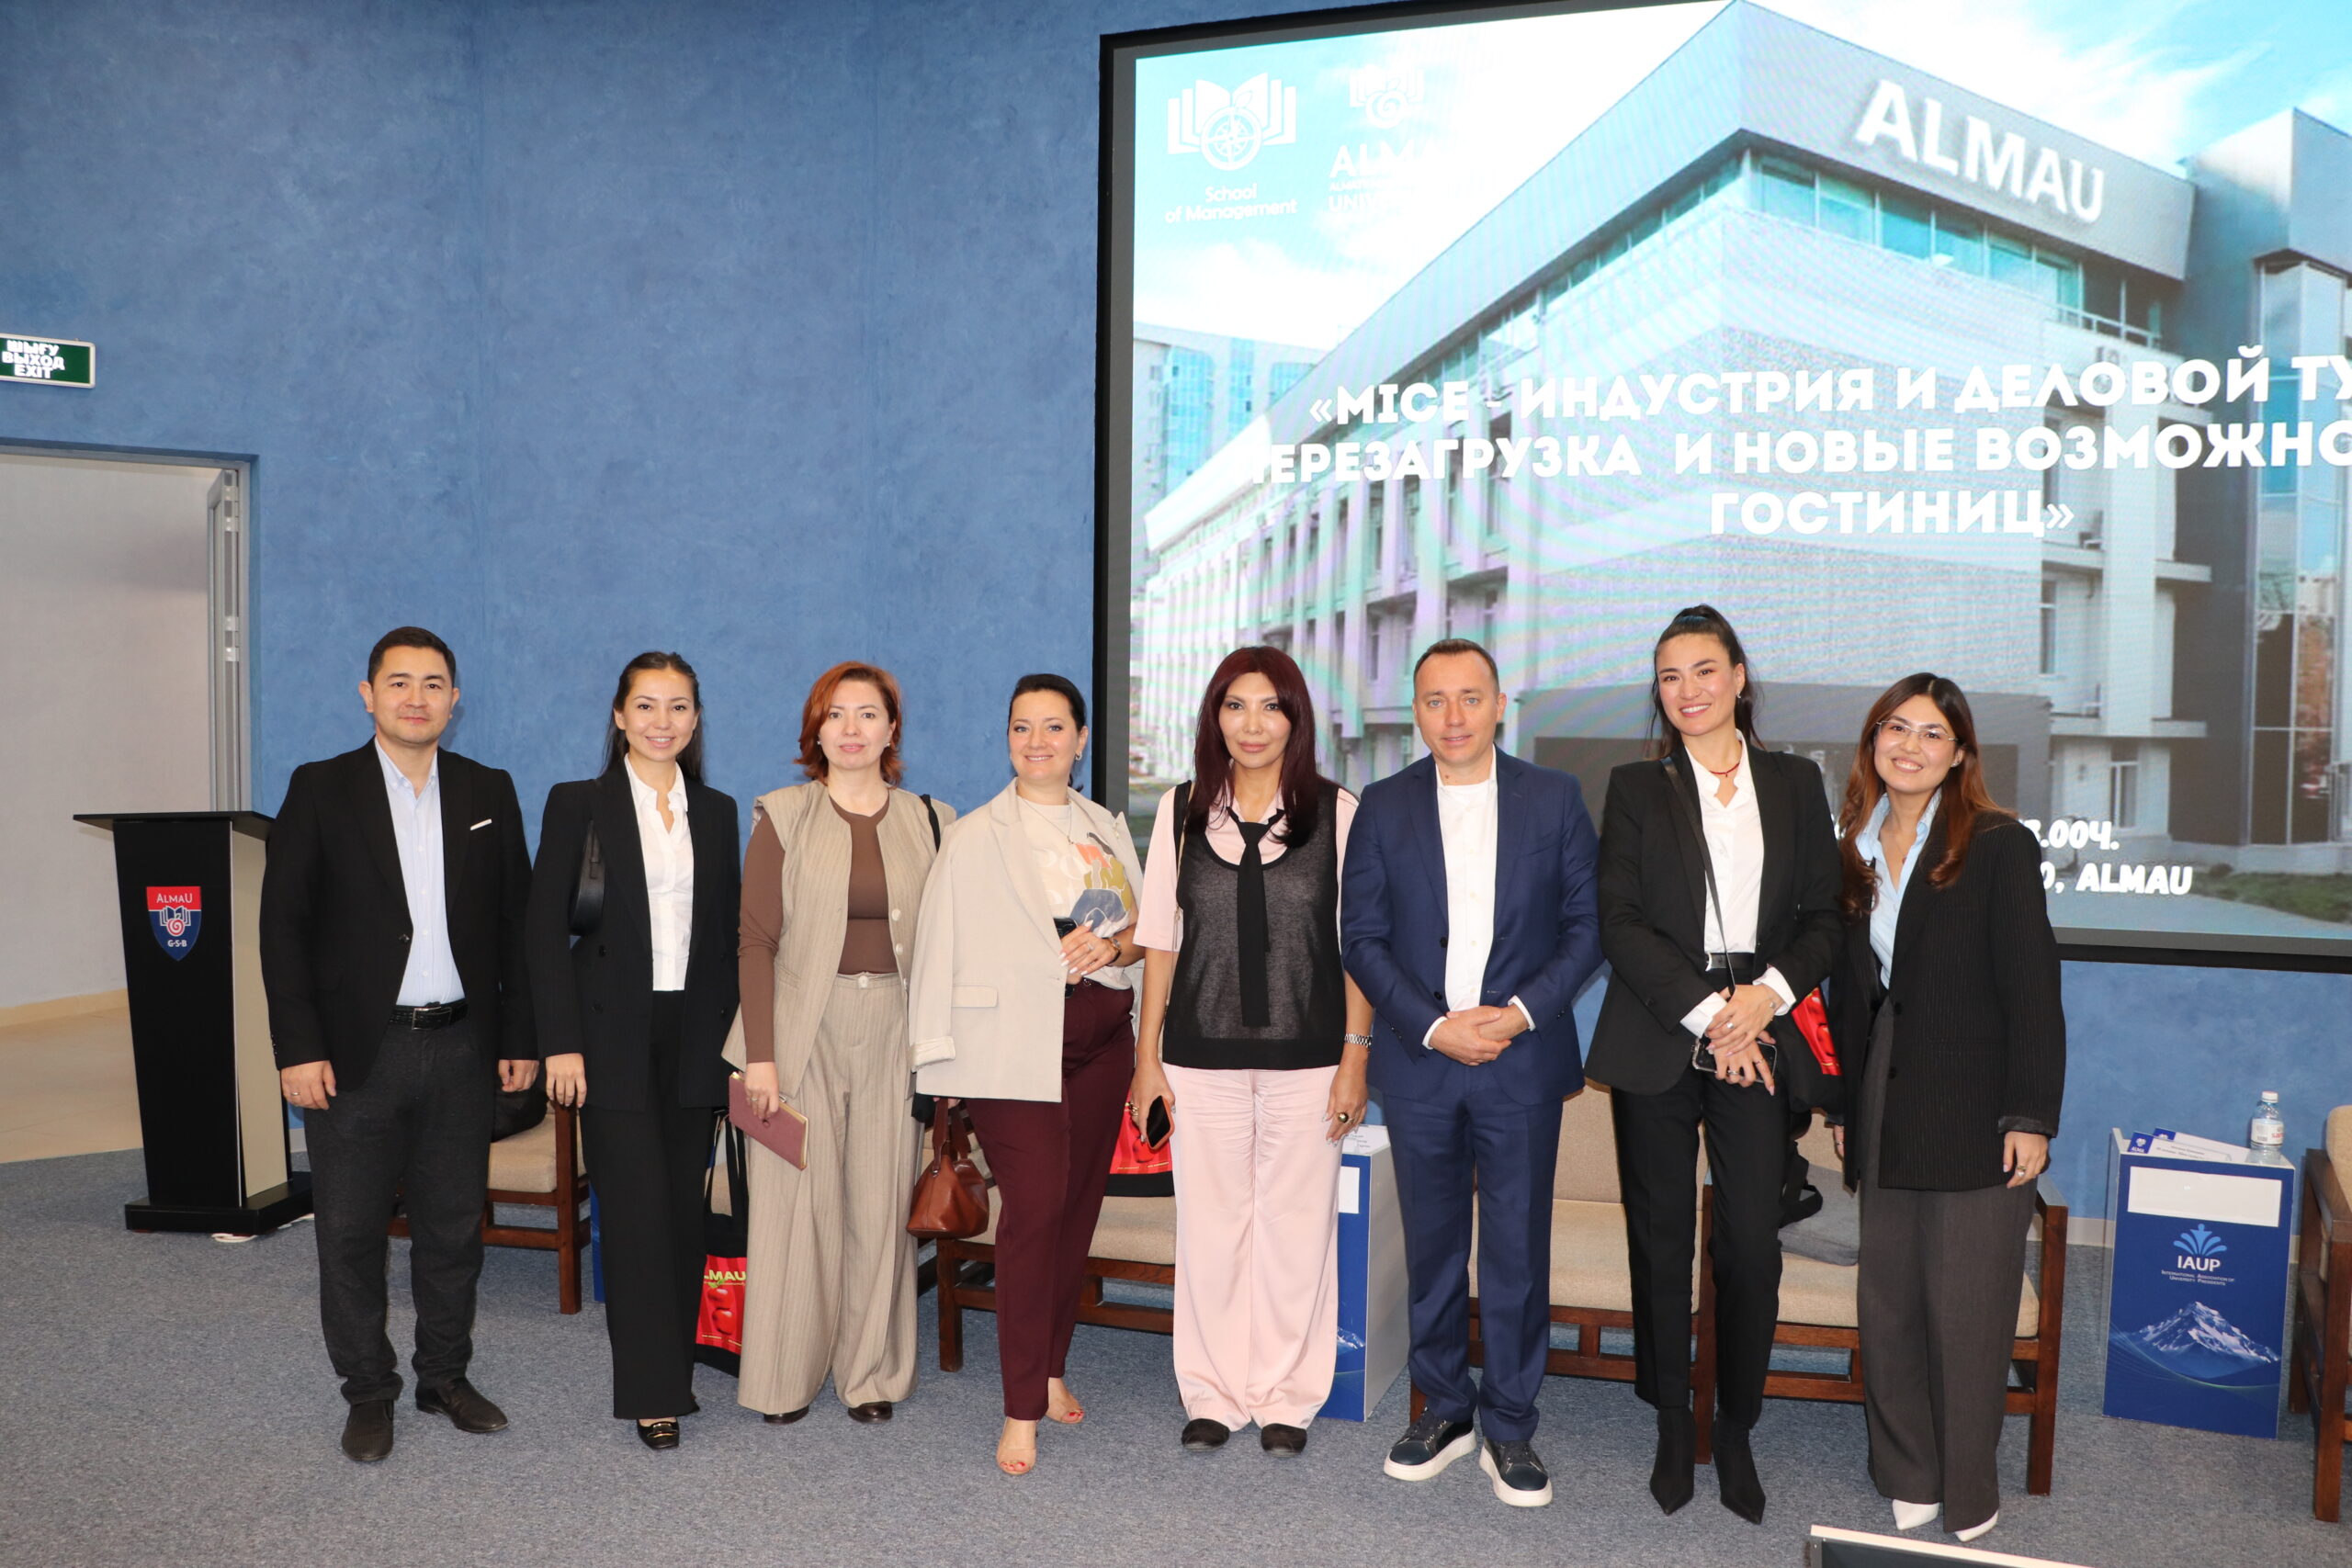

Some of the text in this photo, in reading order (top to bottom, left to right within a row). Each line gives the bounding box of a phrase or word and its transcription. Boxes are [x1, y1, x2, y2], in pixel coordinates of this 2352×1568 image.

[1854, 78, 2105, 222] ALMAU
[1204, 183, 1258, 203] School
[1164, 198, 1298, 223] of Management
[2, 351, 65, 370] ВЫХОД
[14, 364, 52, 378] EXIT
[1521, 367, 1873, 422] ИНДУСТРИЯ
[1896, 367, 1937, 411] И
[1954, 344, 2269, 413] ДЕЛОВОЙ
[1674, 432, 1713, 476] И
[1734, 427, 1954, 475] НОВЫЕ
[1976, 420, 2352, 471] ВОЗМОЖНО
[1710, 490, 2075, 538] ГОСТИНИЦ»
[2075, 862, 2193, 895] ALMAU
[704, 1269, 747, 1281] MAU
[2177, 1255, 2221, 1272] IAUP
